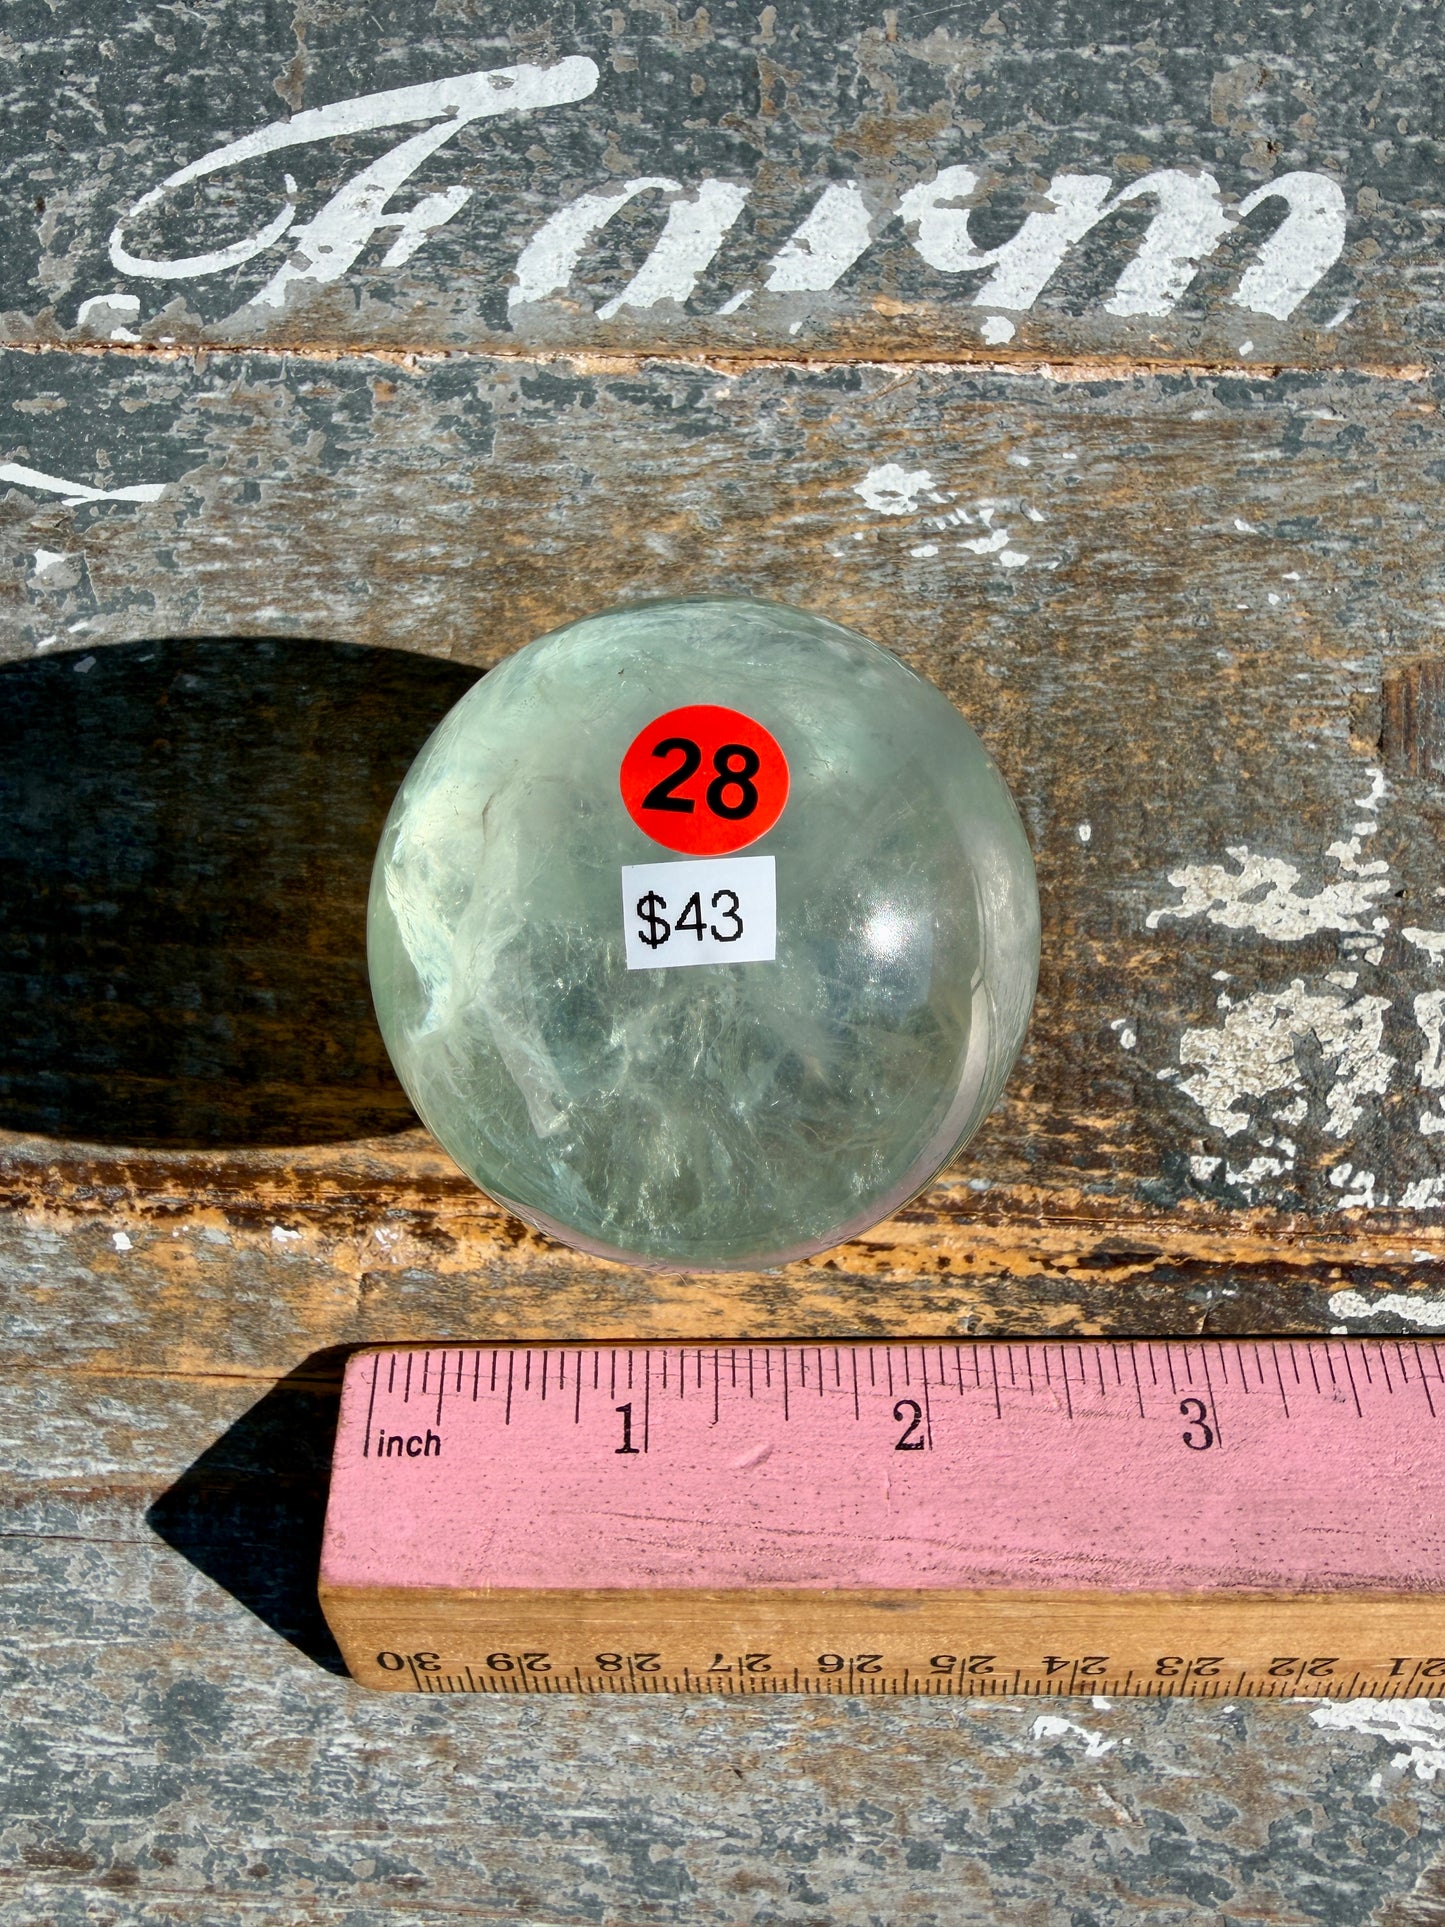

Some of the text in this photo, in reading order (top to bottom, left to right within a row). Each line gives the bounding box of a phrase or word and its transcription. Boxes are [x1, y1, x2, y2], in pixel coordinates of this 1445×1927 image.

[641, 737, 761, 820] 28
[636, 890, 744, 949] $43
[376, 1398, 1214, 1458] inch 1 2 3
[376, 1651, 442, 1671] 30
[486, 1652, 552, 1672] 29
[595, 1652, 662, 1672] 28
[708, 1653, 772, 1673] 27
[818, 1654, 884, 1674] 26
[930, 1655, 997, 1675] 25
[1042, 1656, 1110, 1675] 24
[1156, 1657, 1225, 1676] 23
[1268, 1657, 1340, 1677] 22
